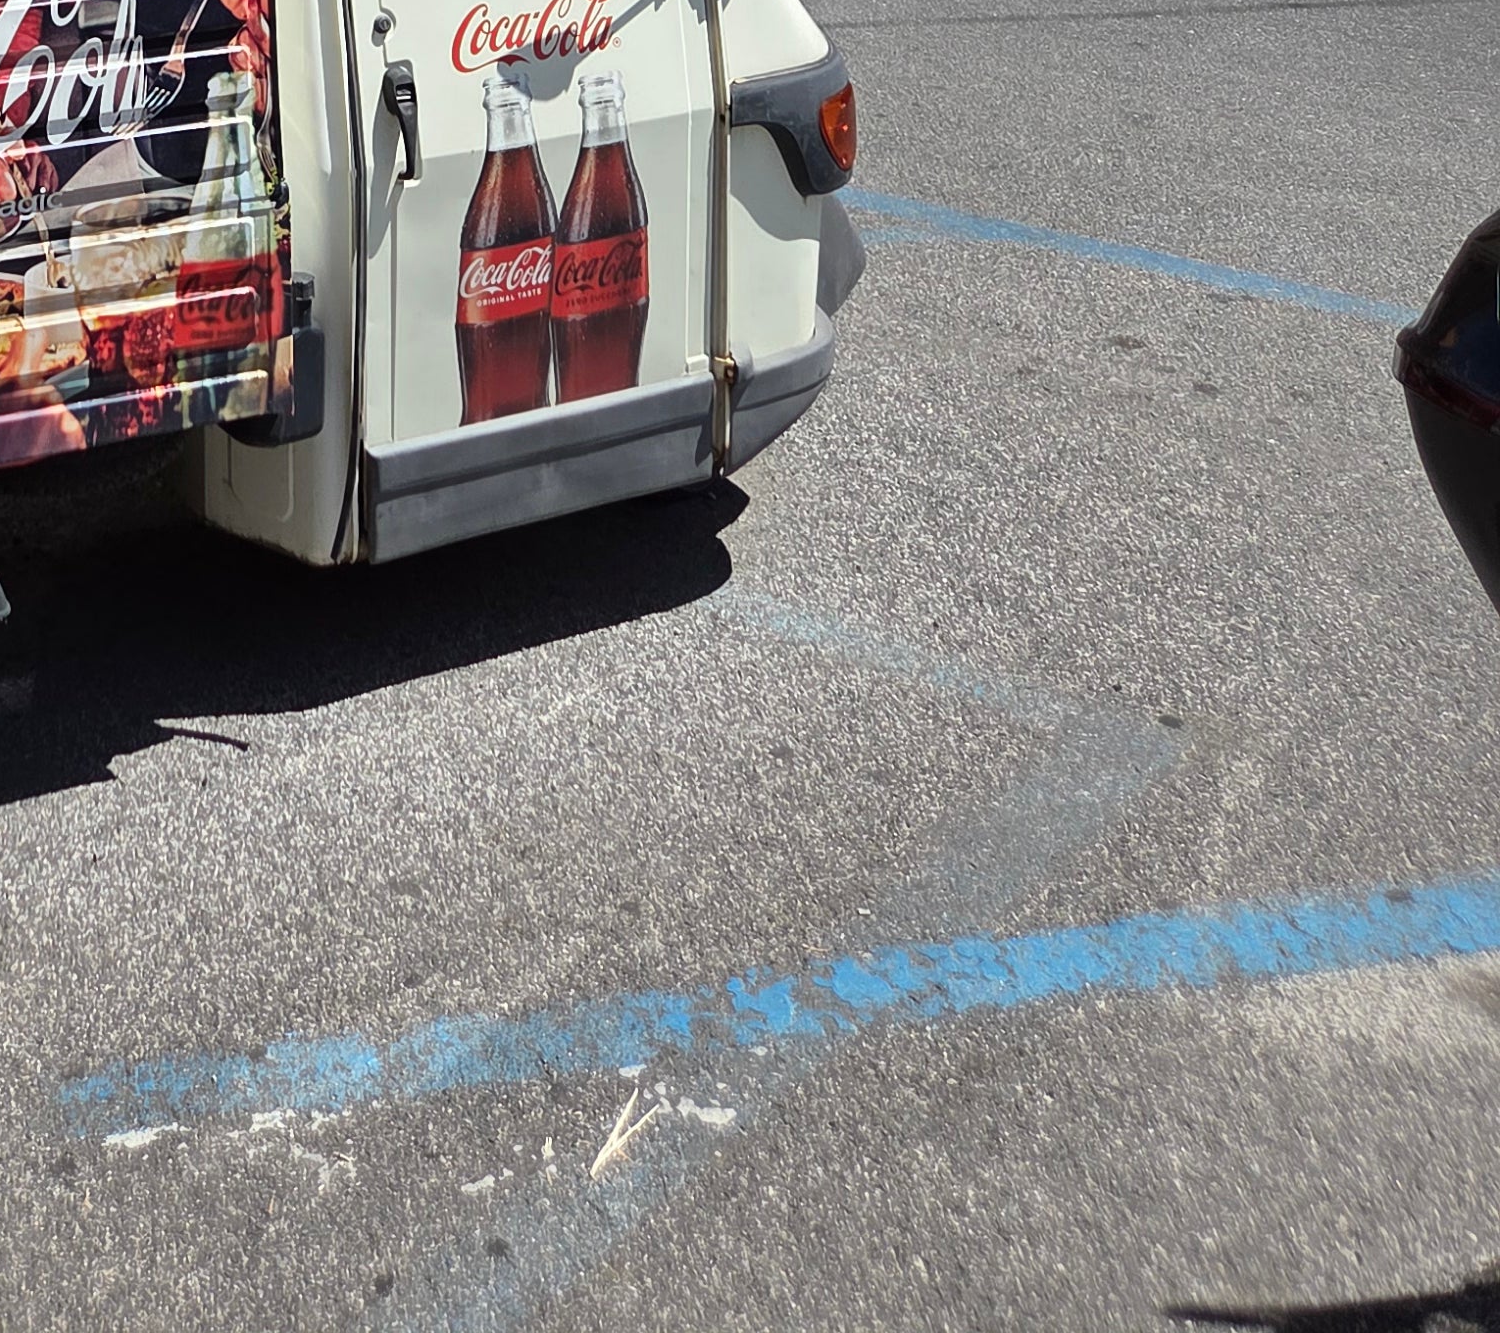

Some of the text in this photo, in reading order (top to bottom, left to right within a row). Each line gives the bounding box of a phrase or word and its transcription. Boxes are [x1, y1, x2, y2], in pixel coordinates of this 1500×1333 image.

[555, 239, 643, 296] Coca-Cola
[476, 287, 542, 308] ORIGINAL TASTE
